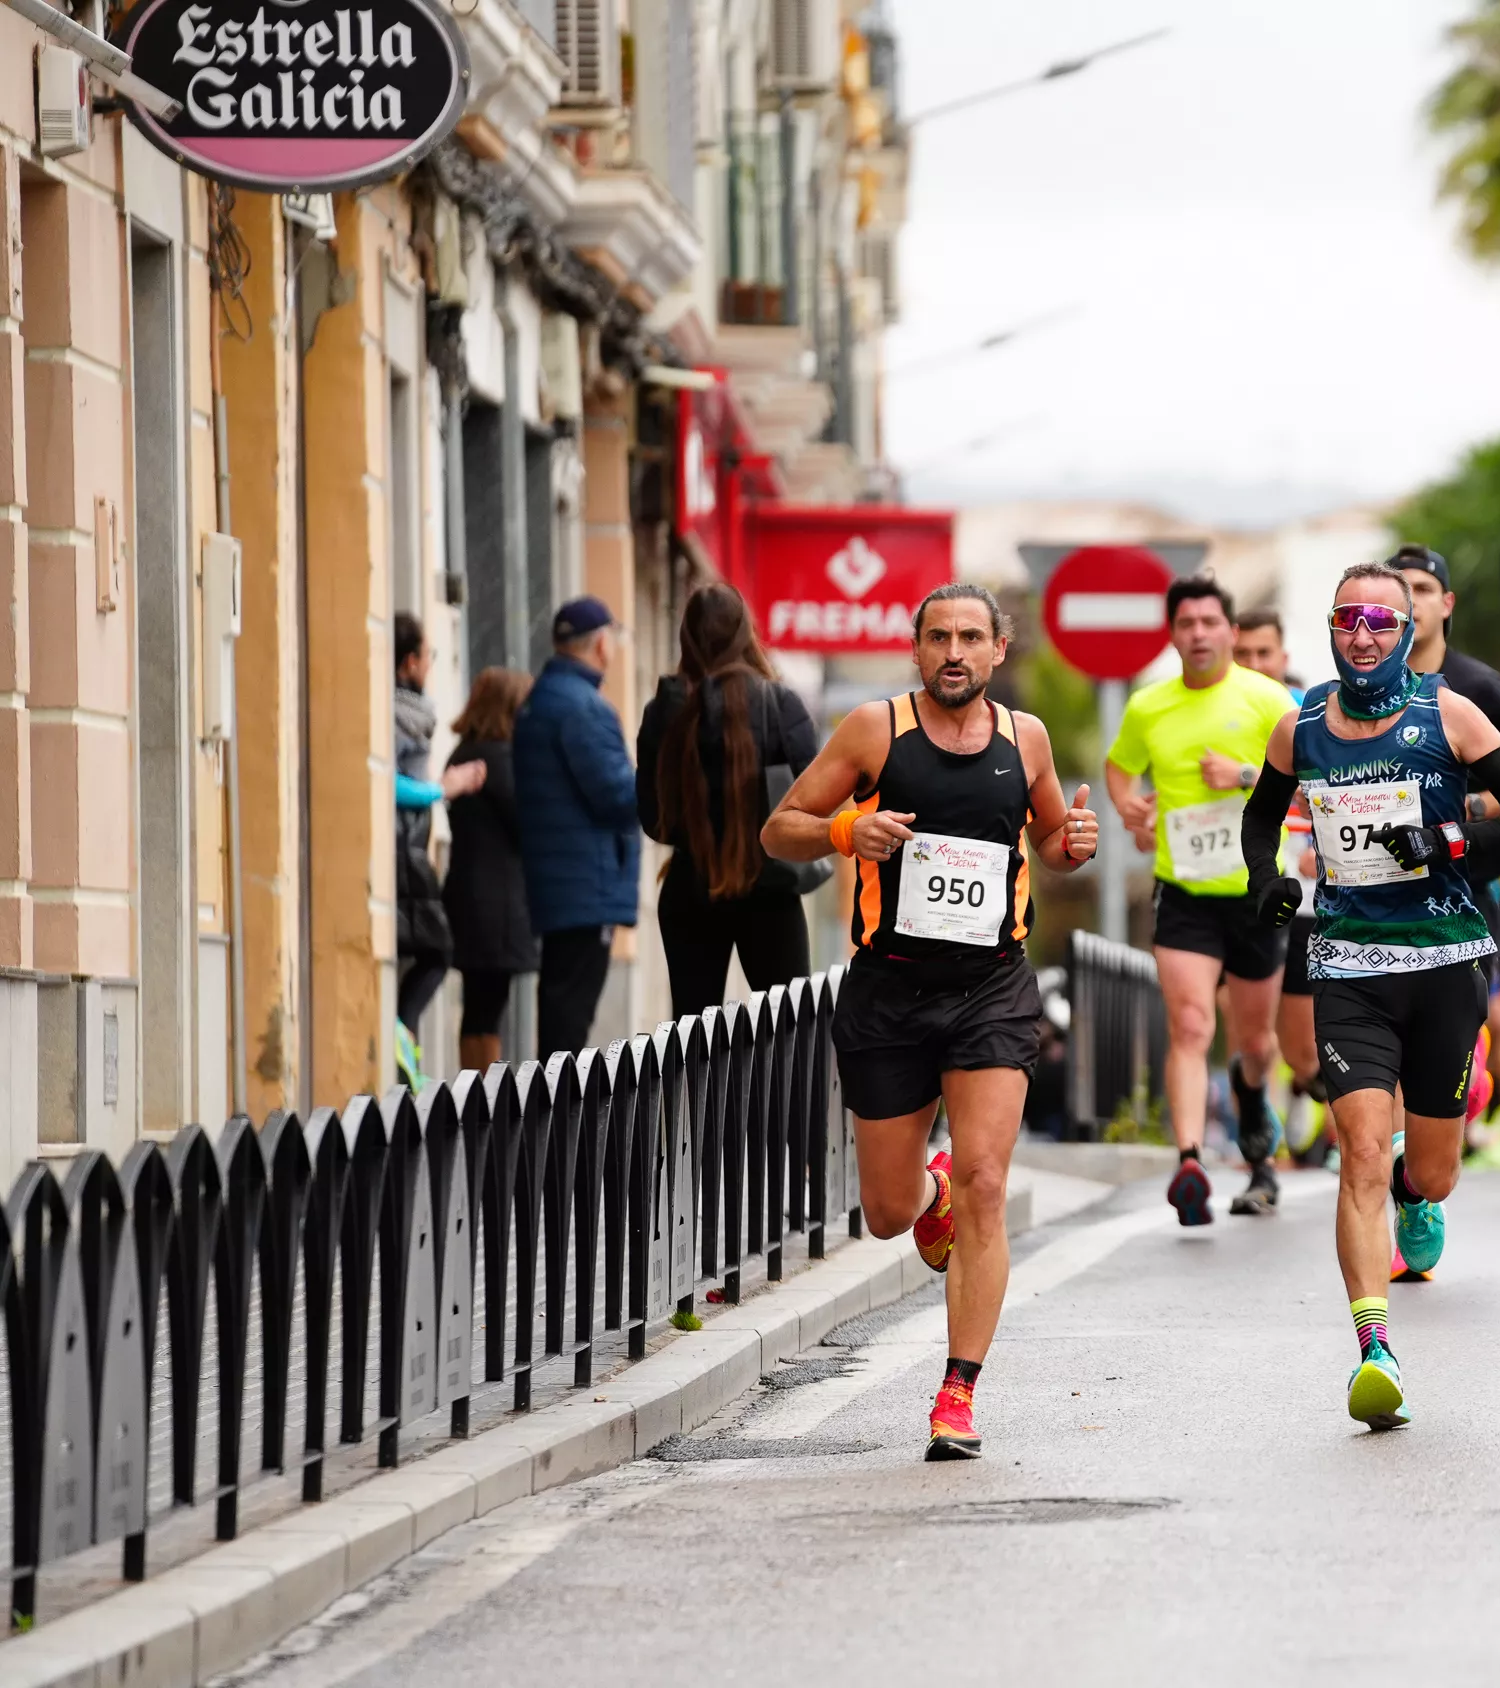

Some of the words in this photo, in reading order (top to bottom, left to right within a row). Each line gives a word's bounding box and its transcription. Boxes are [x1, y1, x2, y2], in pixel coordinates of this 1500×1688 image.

[172, 4, 417, 68] Estrella
[187, 66, 406, 130] Galicia
[769, 600, 915, 641] FREMA
[1330, 756, 1403, 782] RUNNING
[1351, 803, 1385, 814] LUCENA
[1190, 828, 1233, 855] 972
[947, 857, 979, 869] LUCENA
[927, 876, 985, 908] 950
[1455, 1069, 1468, 1099] FILA
